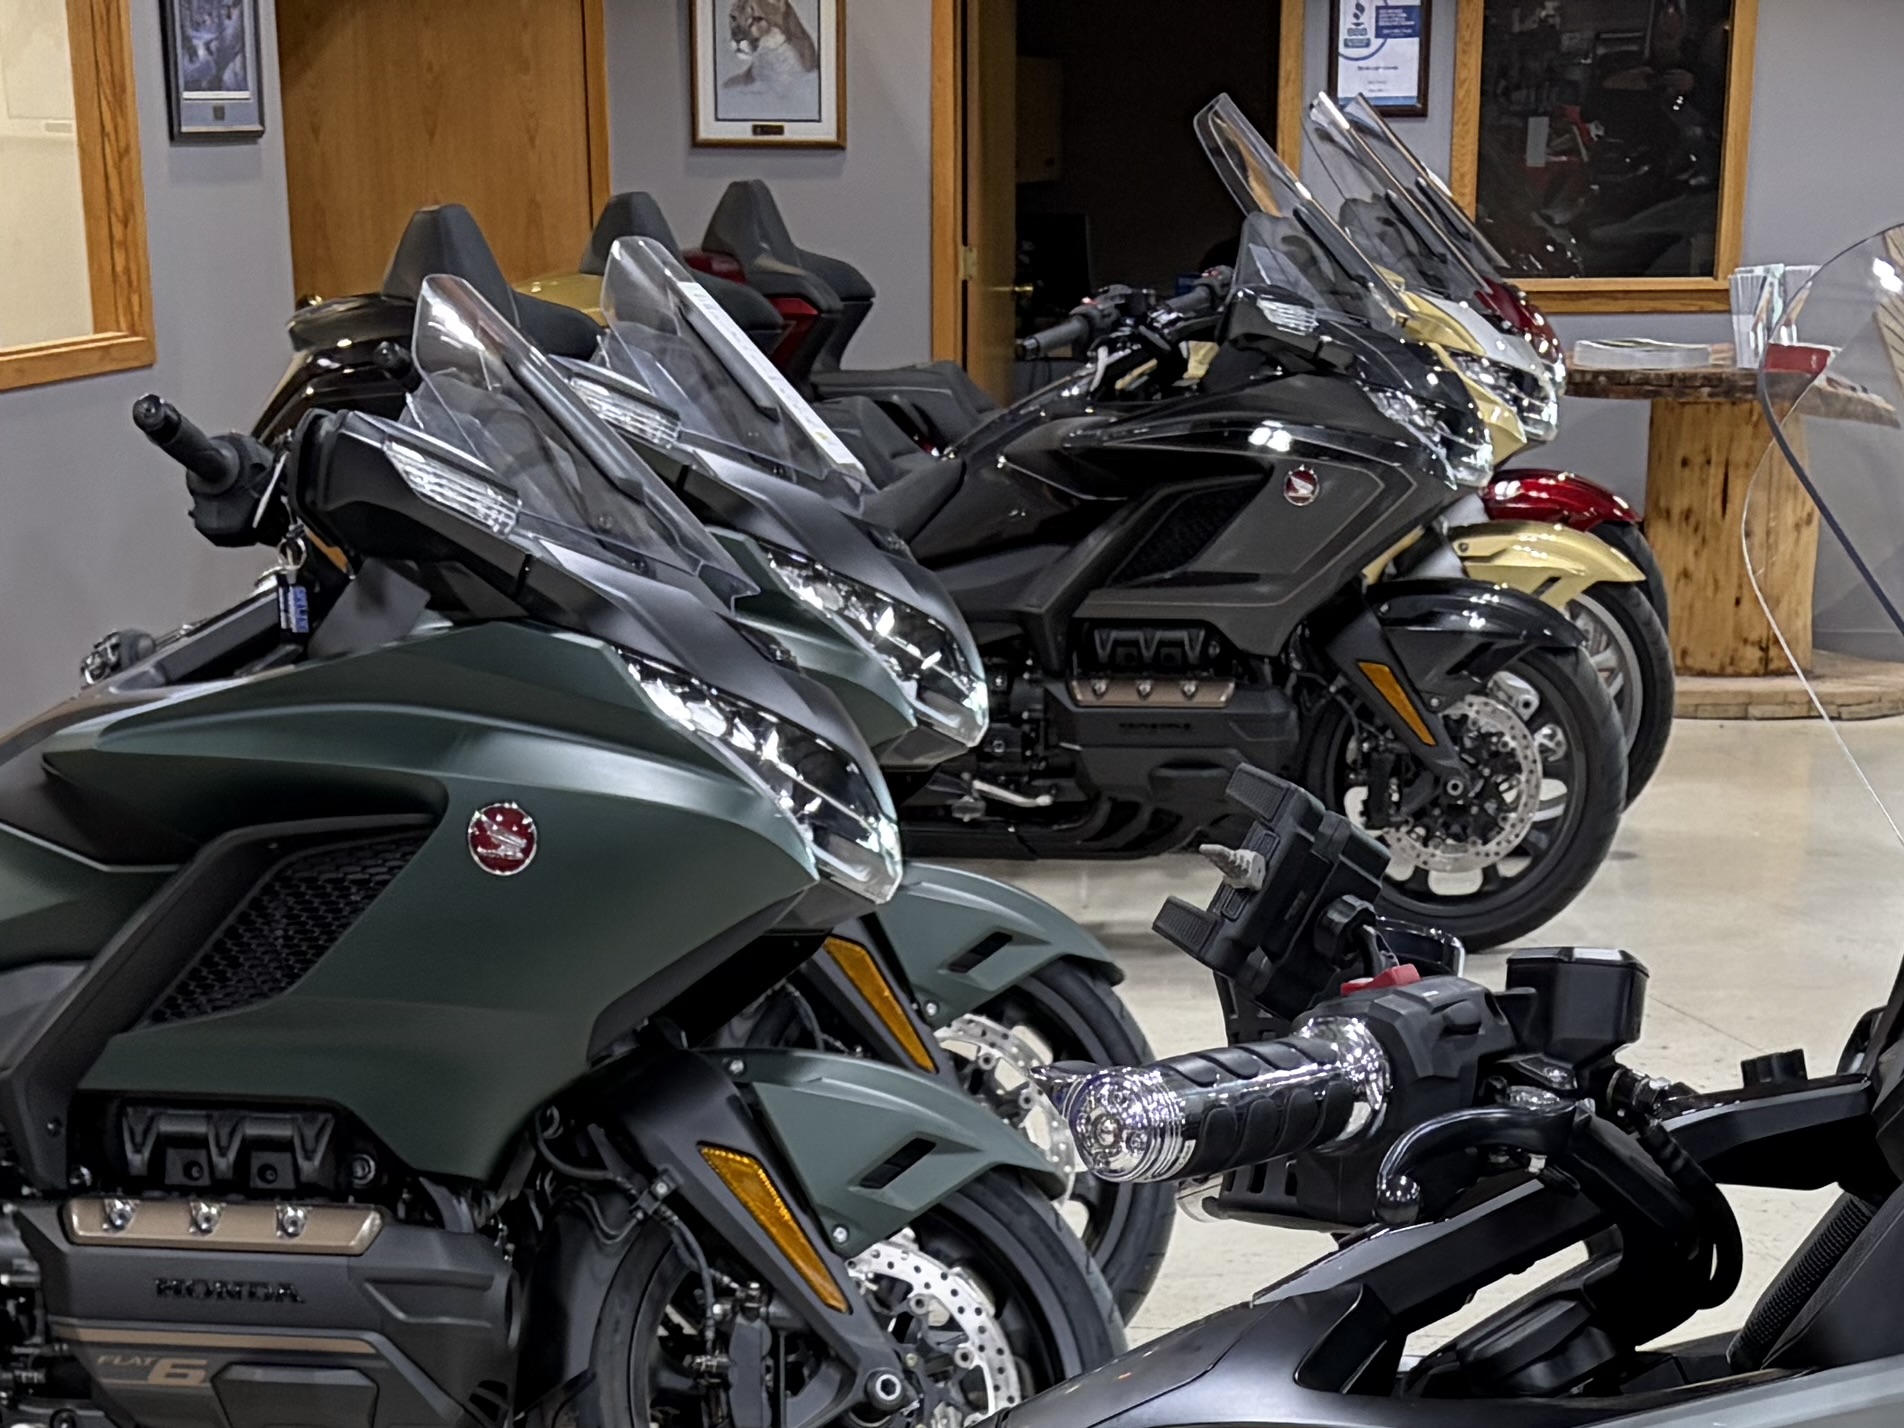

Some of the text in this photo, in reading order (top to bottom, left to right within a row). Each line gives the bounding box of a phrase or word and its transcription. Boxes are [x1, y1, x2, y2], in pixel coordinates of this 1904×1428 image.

[154, 1277, 306, 1304] HONDA
[98, 1354, 208, 1386] FLAT 6
